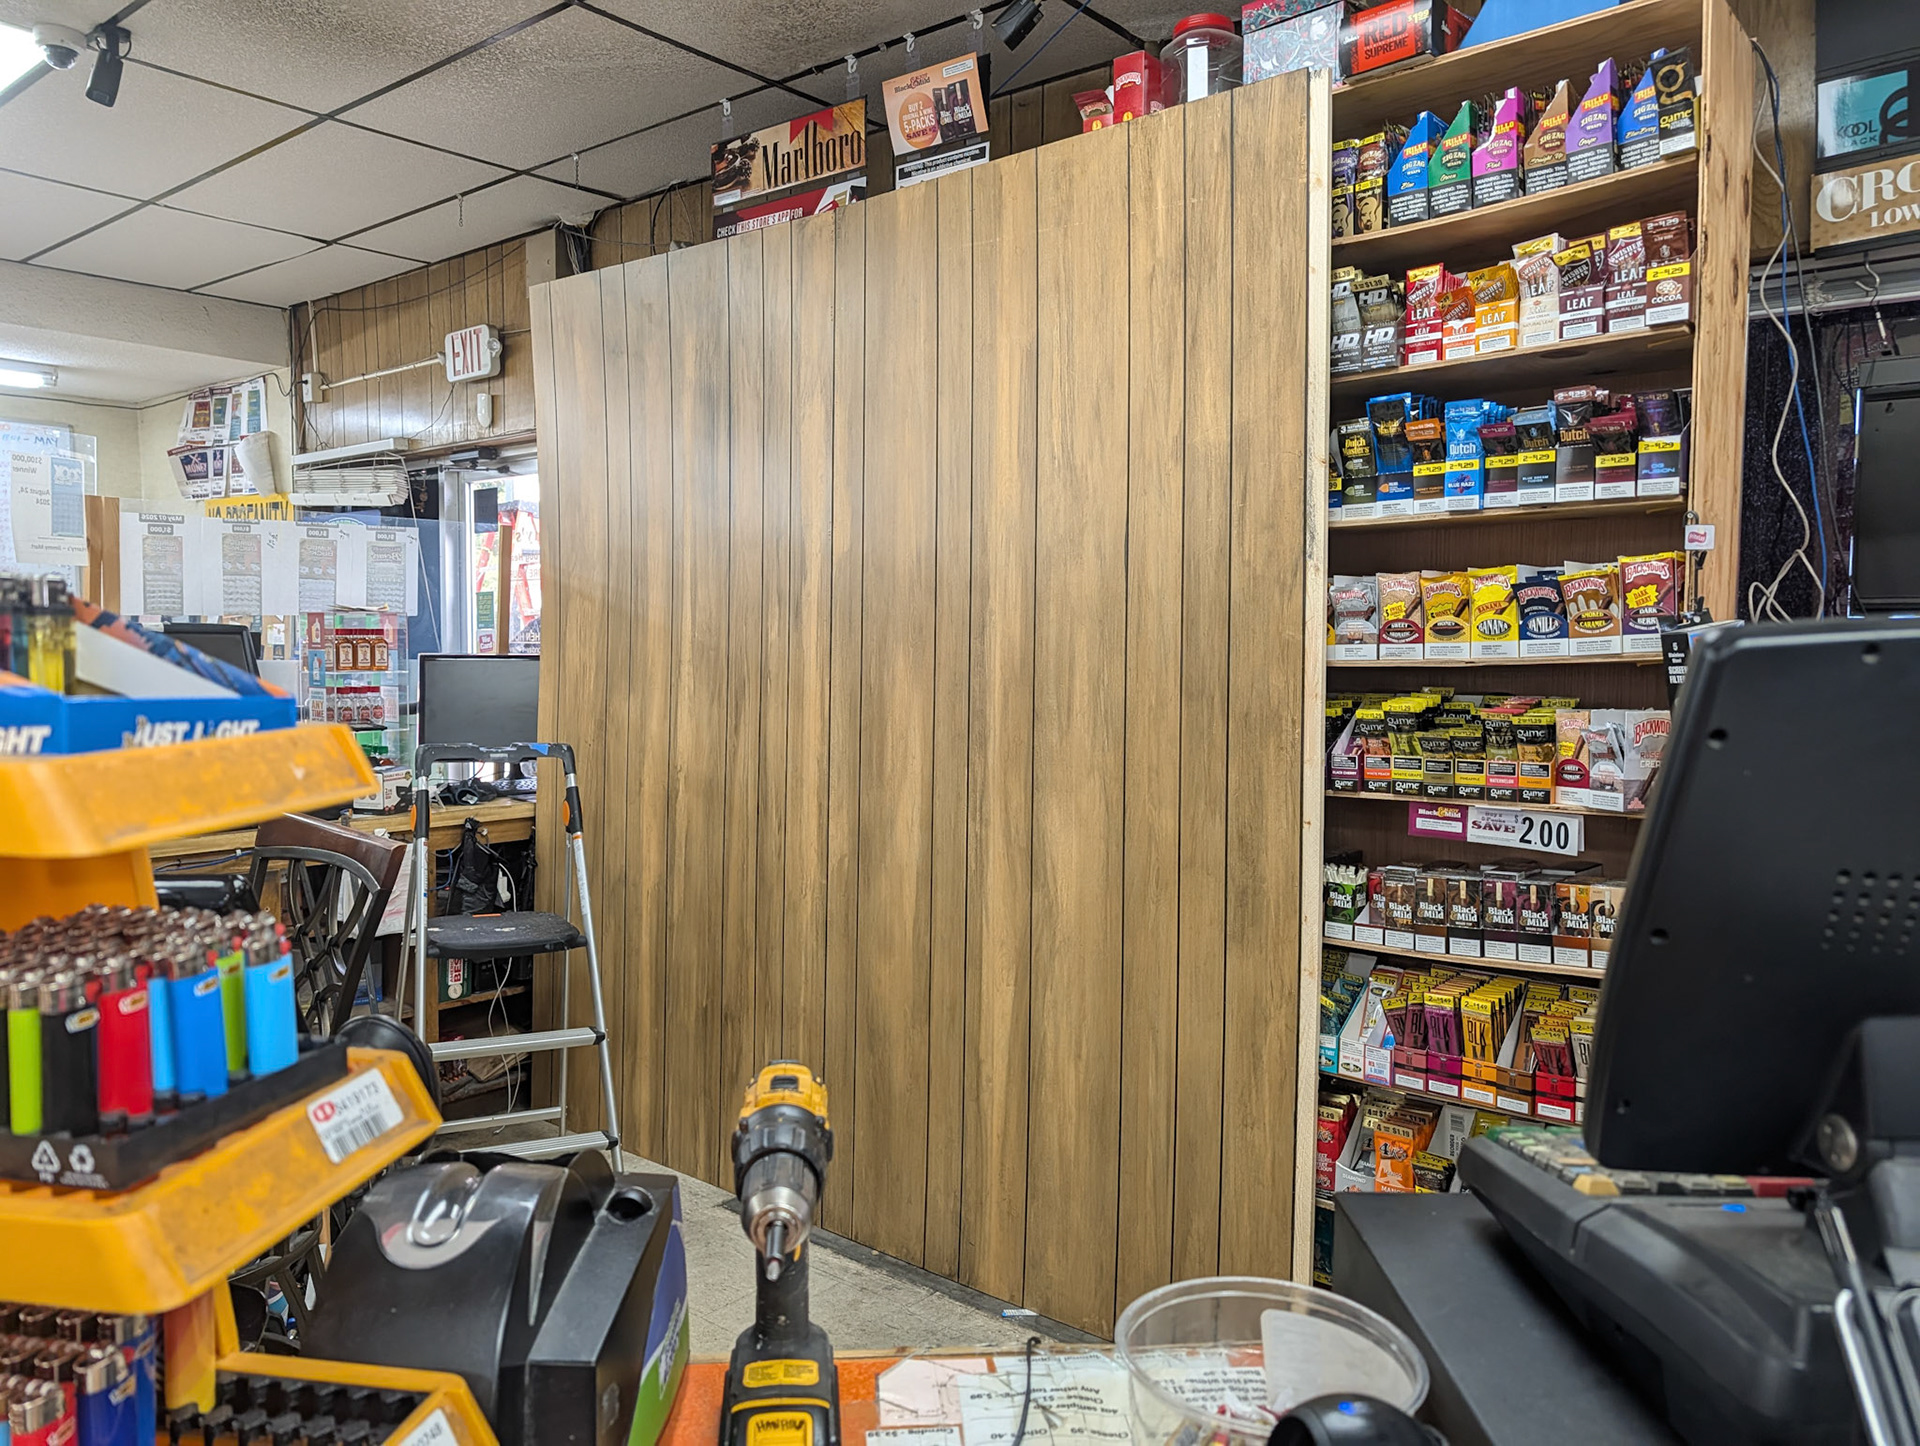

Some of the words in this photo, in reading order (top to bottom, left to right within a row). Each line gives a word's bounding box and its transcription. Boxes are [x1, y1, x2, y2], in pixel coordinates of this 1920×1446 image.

[1364, 11, 1407, 46] RED
[1365, 37, 1408, 60] SUPREME
[908, 103, 919, 113] BUY
[904, 114, 936, 133] 5-PACKS
[1660, 109, 1693, 129] game
[906, 130, 928, 141] SAVE
[761, 120, 863, 189] Marlboro
[716, 223, 736, 239] CHECK
[737, 220, 750, 233] THIS
[752, 214, 776, 229] STORE'S
[777, 209, 790, 223] APP
[791, 207, 803, 220] FOR
[1609, 241, 1644, 262] SWISHER
[1563, 266, 1588, 284] SWISHER
[1614, 265, 1645, 284] LEAF
[1365, 279, 1383, 289] $1.39
[1525, 280, 1554, 297] LEAF
[1359, 288, 1387, 305] HD
[1408, 282, 1433, 301] SWISHER
[1477, 282, 1502, 302] SWISHER
[1617, 290, 1636, 299] LEAF
[1566, 296, 1594, 311] LEAF
[1651, 293, 1682, 304] COCOA
[1411, 306, 1436, 321] LEAF
[1481, 310, 1507, 325] LEAF
[1363, 326, 1394, 346] HD
[1414, 326, 1430, 335] LEAF
[1452, 327, 1468, 335] LEAF
[1332, 332, 1360, 350] HD
[451, 327, 482, 377] EXIT
[1560, 428, 1590, 442] Dutch
[1345, 437, 1366, 447] Dutch
[1523, 438, 1549, 449] Dutch
[1450, 443, 1476, 456] Dutch
[1625, 561, 1670, 583] BACKWOODS
[1382, 578, 1416, 597] BACKWOODS
[1473, 574, 1511, 593] BACKWOODS
[1564, 577, 1607, 599] BACKWOODS
[1426, 582, 1462, 600] BACKWOODS
[1518, 587, 1558, 604] BACKWOODS
[1633, 588, 1648, 600] DARK
[1635, 596, 1652, 607] BERRY
[1477, 601, 1503, 615] BANANA
[1581, 611, 1605, 619] SMOKED
[1478, 618, 1508, 635] BANANA
[1527, 615, 1560, 633] VANILLA
[1579, 620, 1607, 628] CARAMEL
[1672, 642, 1678, 650] 5
[312, 700, 324, 710] ANY
[1359, 723, 1385, 735] game
[1386, 717, 1415, 731] game
[1485, 721, 1510, 732] game
[124, 714, 190, 748] JUST
[1517, 729, 1545, 742] game
[1421, 740, 1448, 752] game
[1454, 740, 1481, 752] game
[1487, 735, 1513, 745] MVP
[1334, 780, 1354, 790] game
[1368, 781, 1388, 791] game
[1395, 782, 1420, 793] game
[1427, 785, 1448, 795] game
[1459, 786, 1480, 796] game
[1490, 788, 1512, 799] game
[1522, 790, 1545, 800] game
[1418, 808, 1437, 816] Black
[1445, 810, 1461, 818] Mild
[1472, 820, 1516, 834] SAVE
[1519, 817, 1570, 850] 2.00
[1330, 891, 1352, 901] Black
[1389, 902, 1412, 911] Black
[1419, 902, 1444, 911] Black
[1452, 905, 1477, 913] Black
[1488, 907, 1514, 916] Black
[1522, 910, 1549, 919] Black
[1561, 912, 1589, 922] Black
[1430, 1015, 1449, 1040] BLK
[1467, 1020, 1487, 1047] BLK
[1392, 1126, 1410, 1138] $1.19
[1342, 1172, 1366, 1184] DIAMOND
[1415, 1168, 1443, 1179] OPTIMO
[1081, 1385, 1101, 1394] Any
[1065, 1395, 1104, 1404] Cheese
[1053, 1402, 1100, 1412] sampler
[909, 1427, 955, 1435] Corndog
[1090, 1428, 1129, 1439] Cheese
